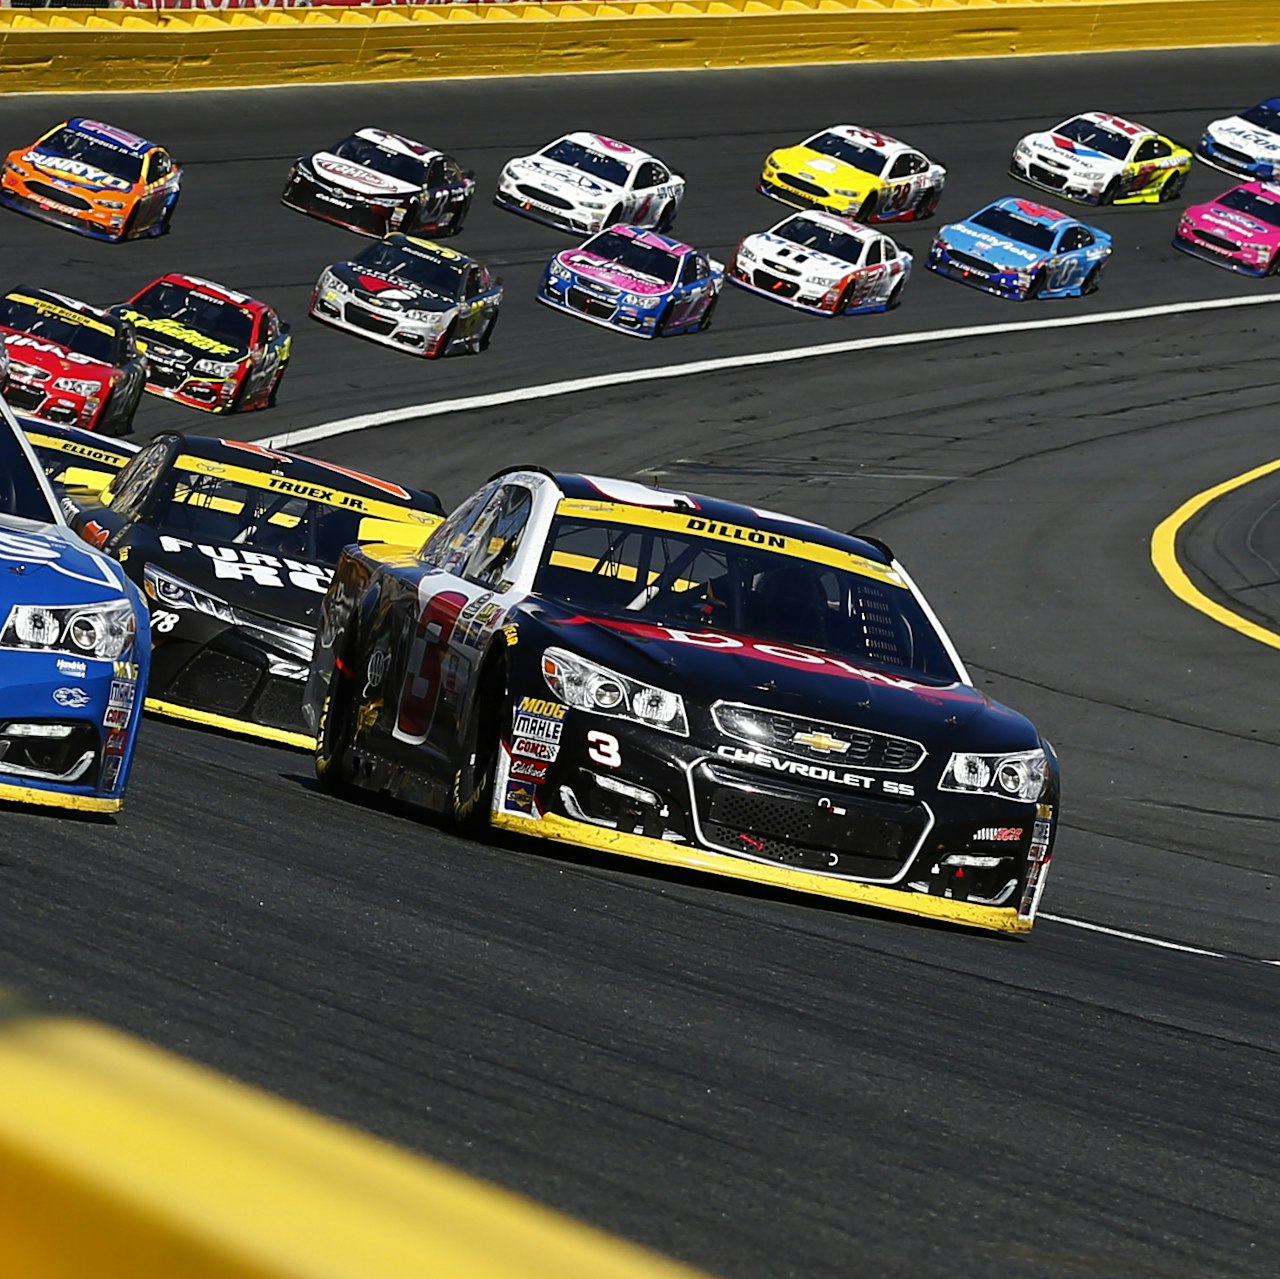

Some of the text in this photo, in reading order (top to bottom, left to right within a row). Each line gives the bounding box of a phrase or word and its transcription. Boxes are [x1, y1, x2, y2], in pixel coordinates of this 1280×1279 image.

[21, 151, 131, 189] SUNNYD
[27, 193, 82, 217] FUSION
[315, 192, 354, 210] CAMRY
[950, 223, 1038, 261] Smithfield
[61, 443, 121, 464] ELLIOTT
[268, 477, 369, 512] TRUEX JR.
[686, 518, 786, 549] DILLON
[149, 610, 180, 633] 78
[56, 659, 87, 672] Hendrick
[518, 696, 570, 719] MOOG
[515, 716, 561, 740] MAHLE
[516, 739, 548, 755] COMP
[587, 730, 622, 768] 3
[511, 761, 546, 779] Edelbrock
[717, 745, 915, 797] CHEVROLET SS
